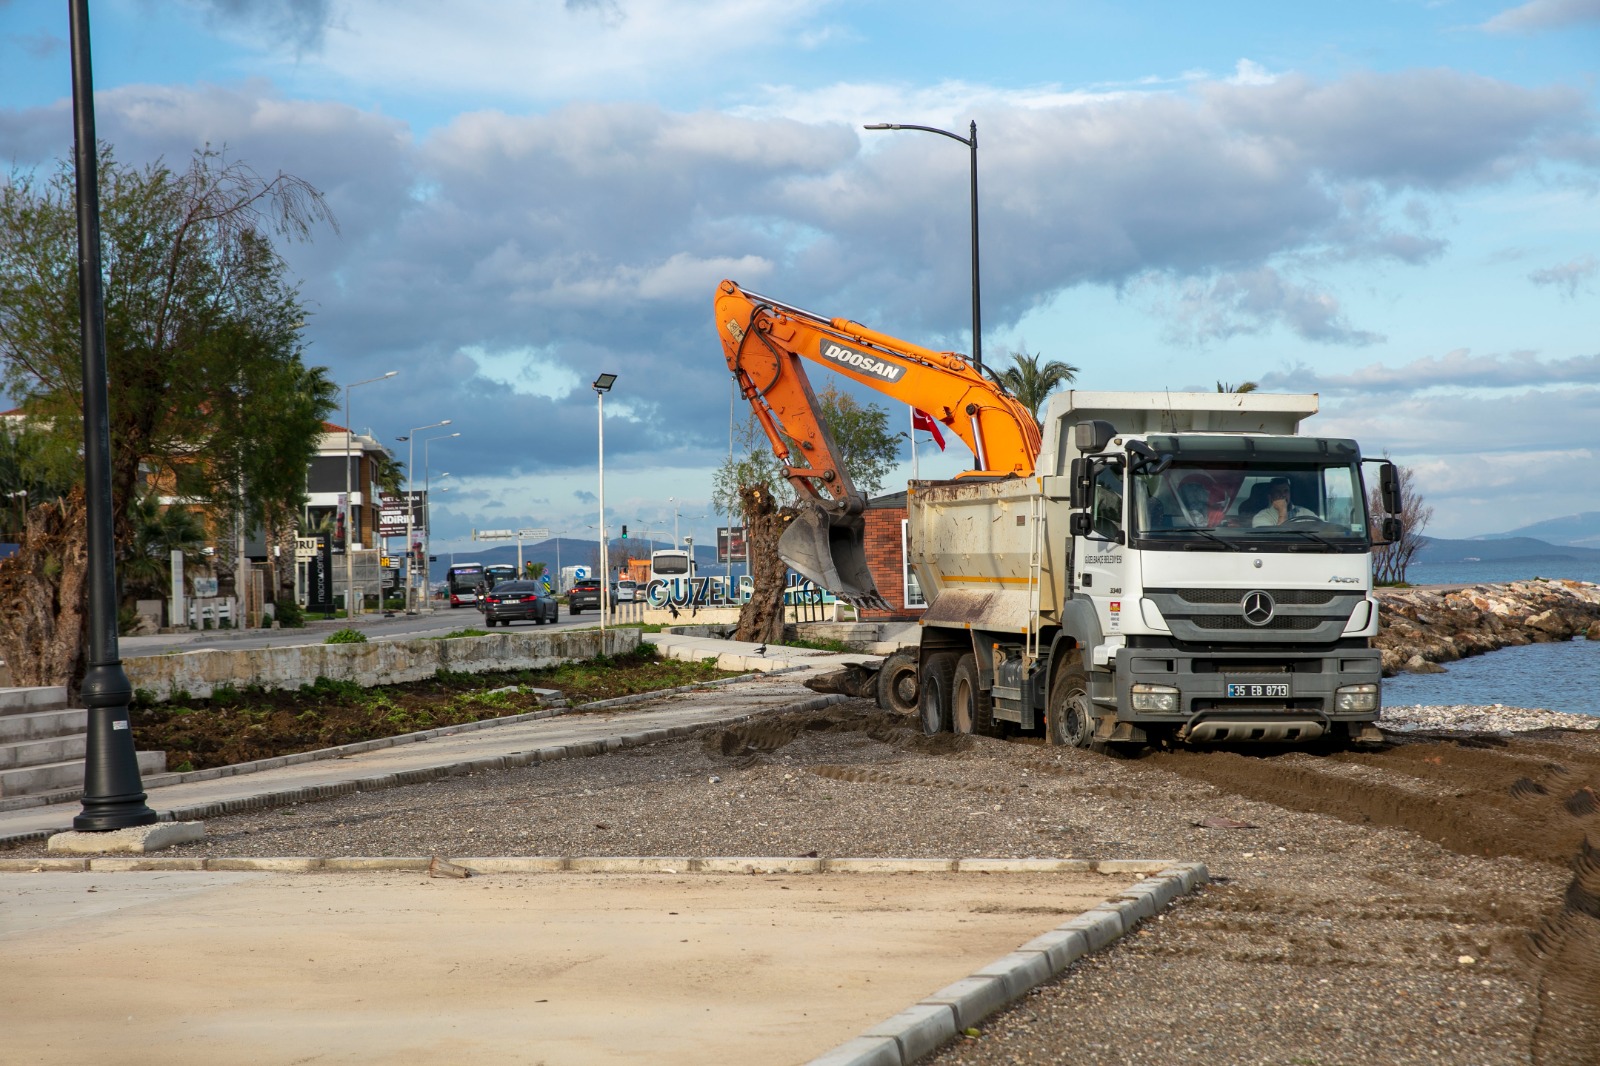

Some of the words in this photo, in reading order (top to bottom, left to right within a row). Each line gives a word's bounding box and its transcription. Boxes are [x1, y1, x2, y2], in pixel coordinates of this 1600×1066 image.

[824, 345, 900, 379] DOOSAN
[1234, 685, 1246, 696] 35
[1251, 685, 1263, 696] EB
[1266, 685, 1287, 696] 8713
